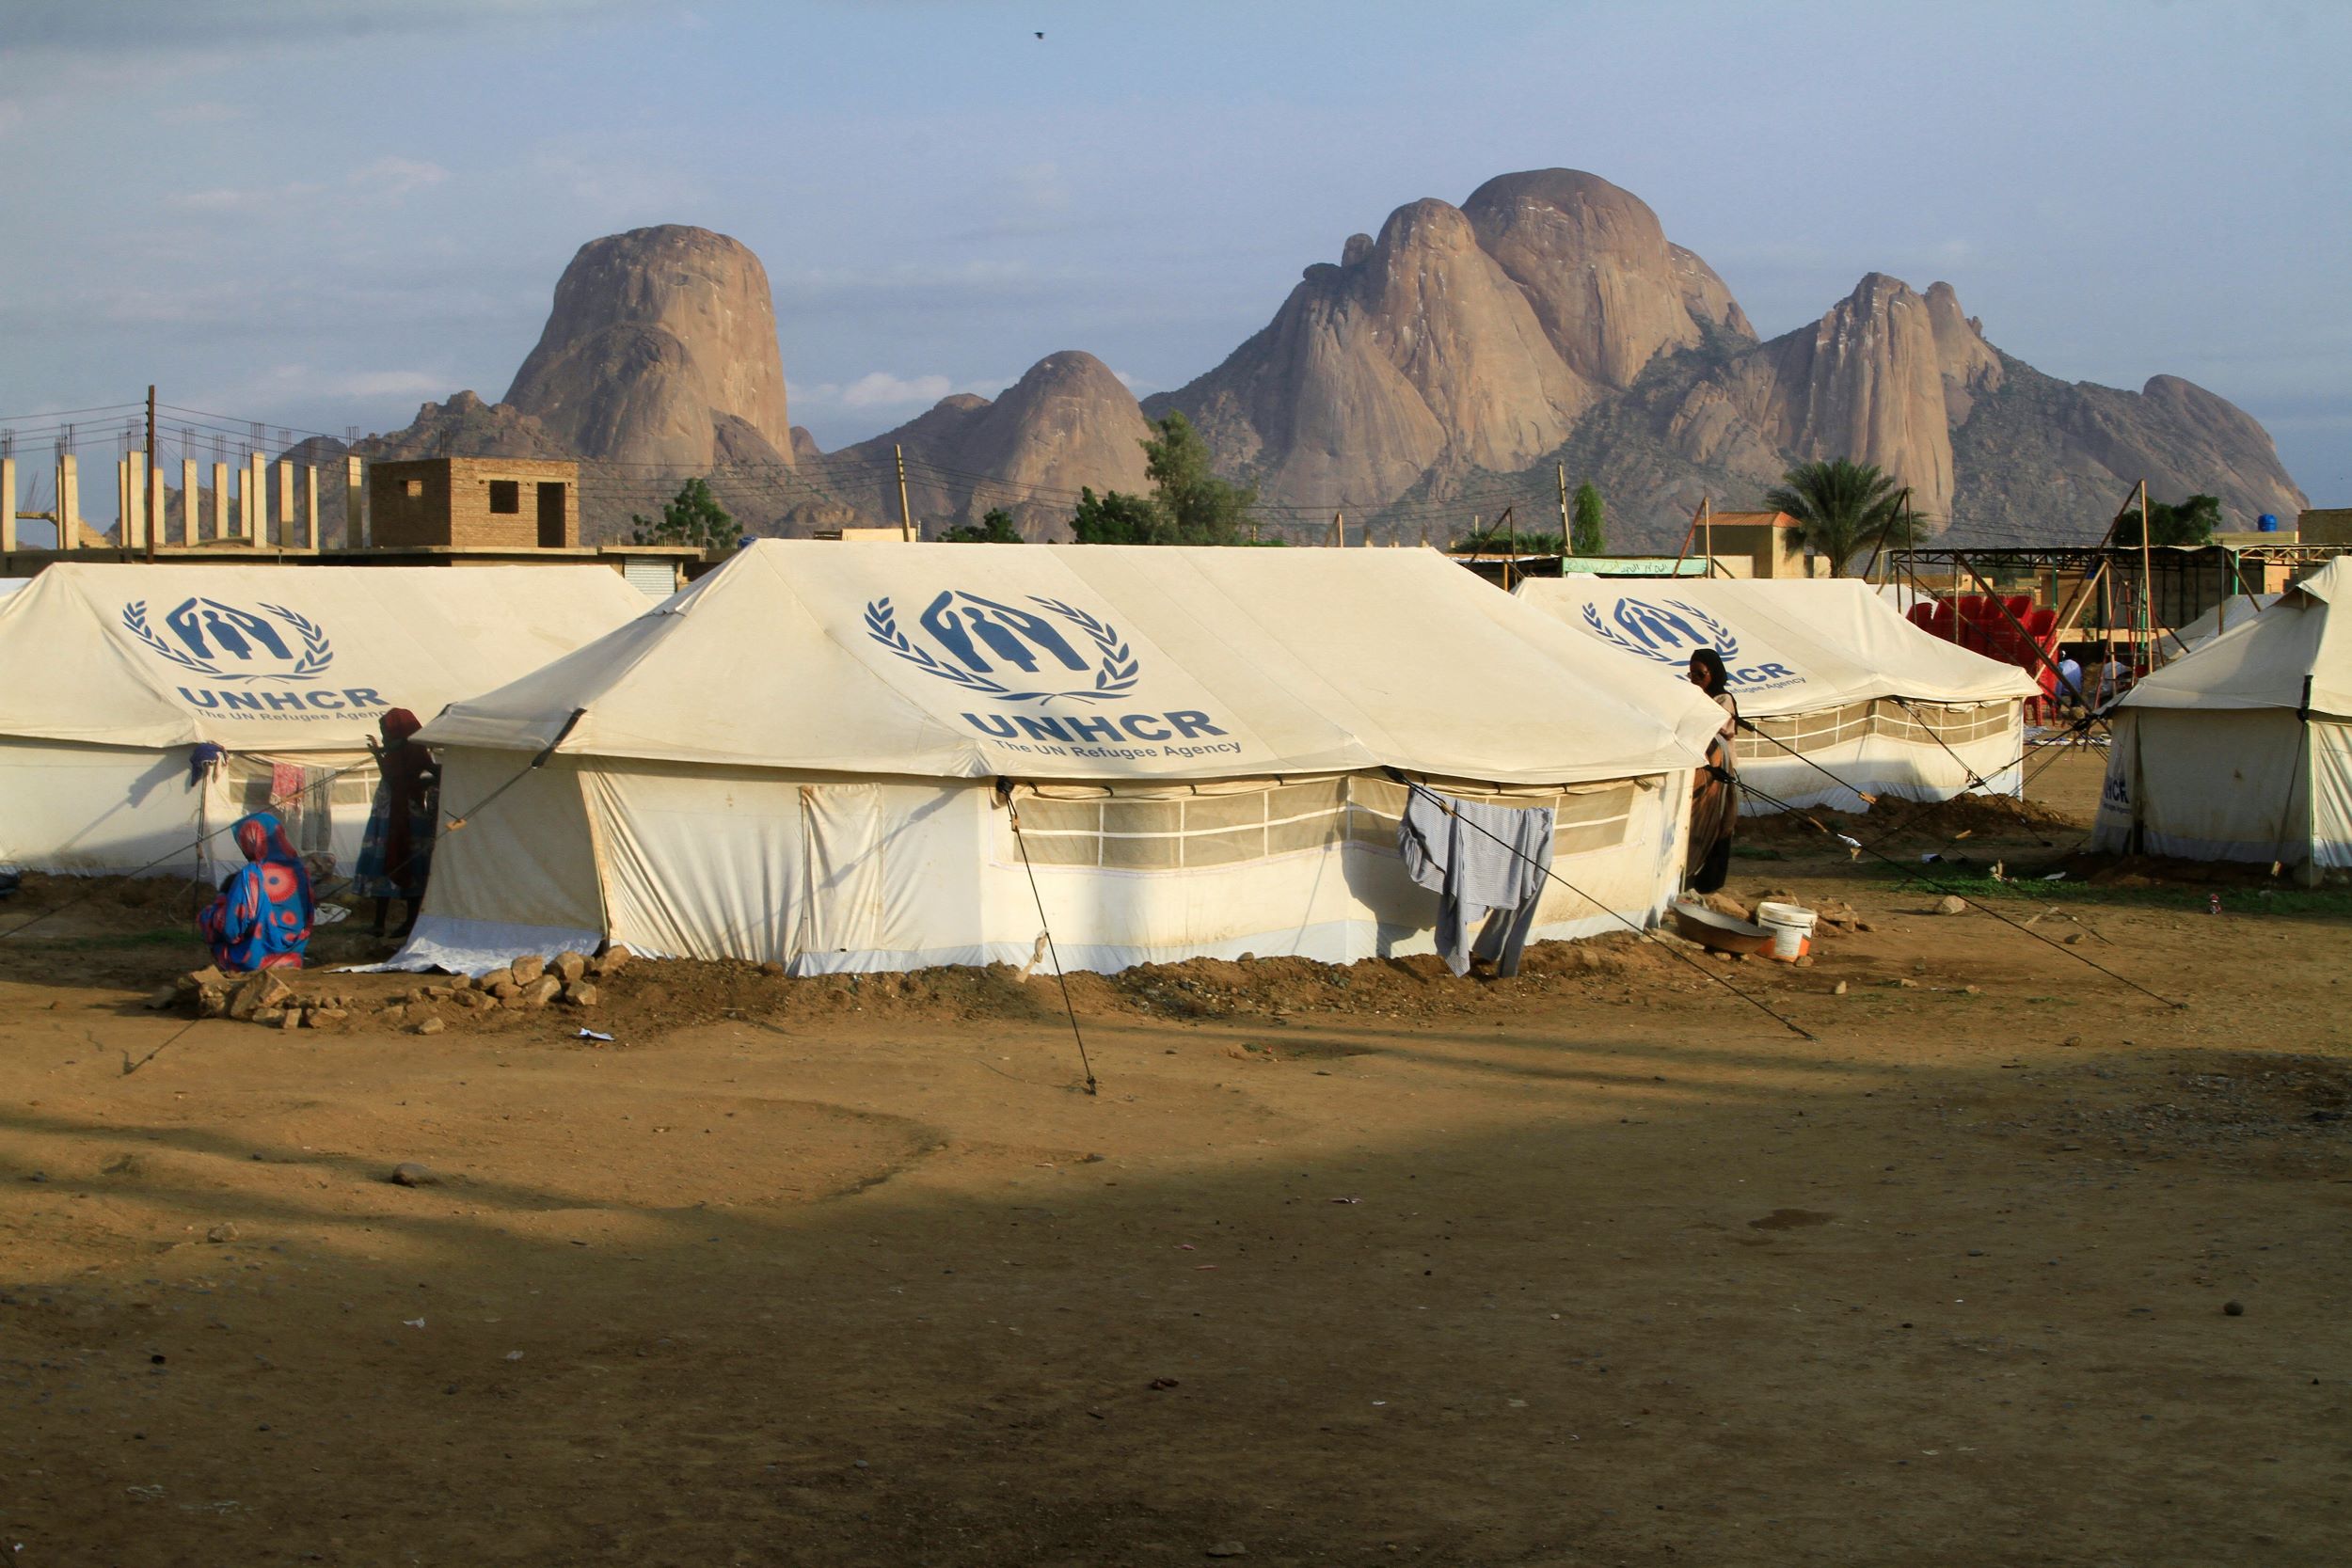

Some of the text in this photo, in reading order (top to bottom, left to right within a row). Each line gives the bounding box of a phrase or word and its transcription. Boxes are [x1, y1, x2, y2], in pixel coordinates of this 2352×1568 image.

[1765, 676, 1806, 689] Agency
[177, 687, 390, 710] UNHCR
[196, 708, 387, 721] The UN Refugee Agenc
[960, 710, 1230, 742] UNHCR
[992, 739, 1242, 760] The UN Refugee Agency
